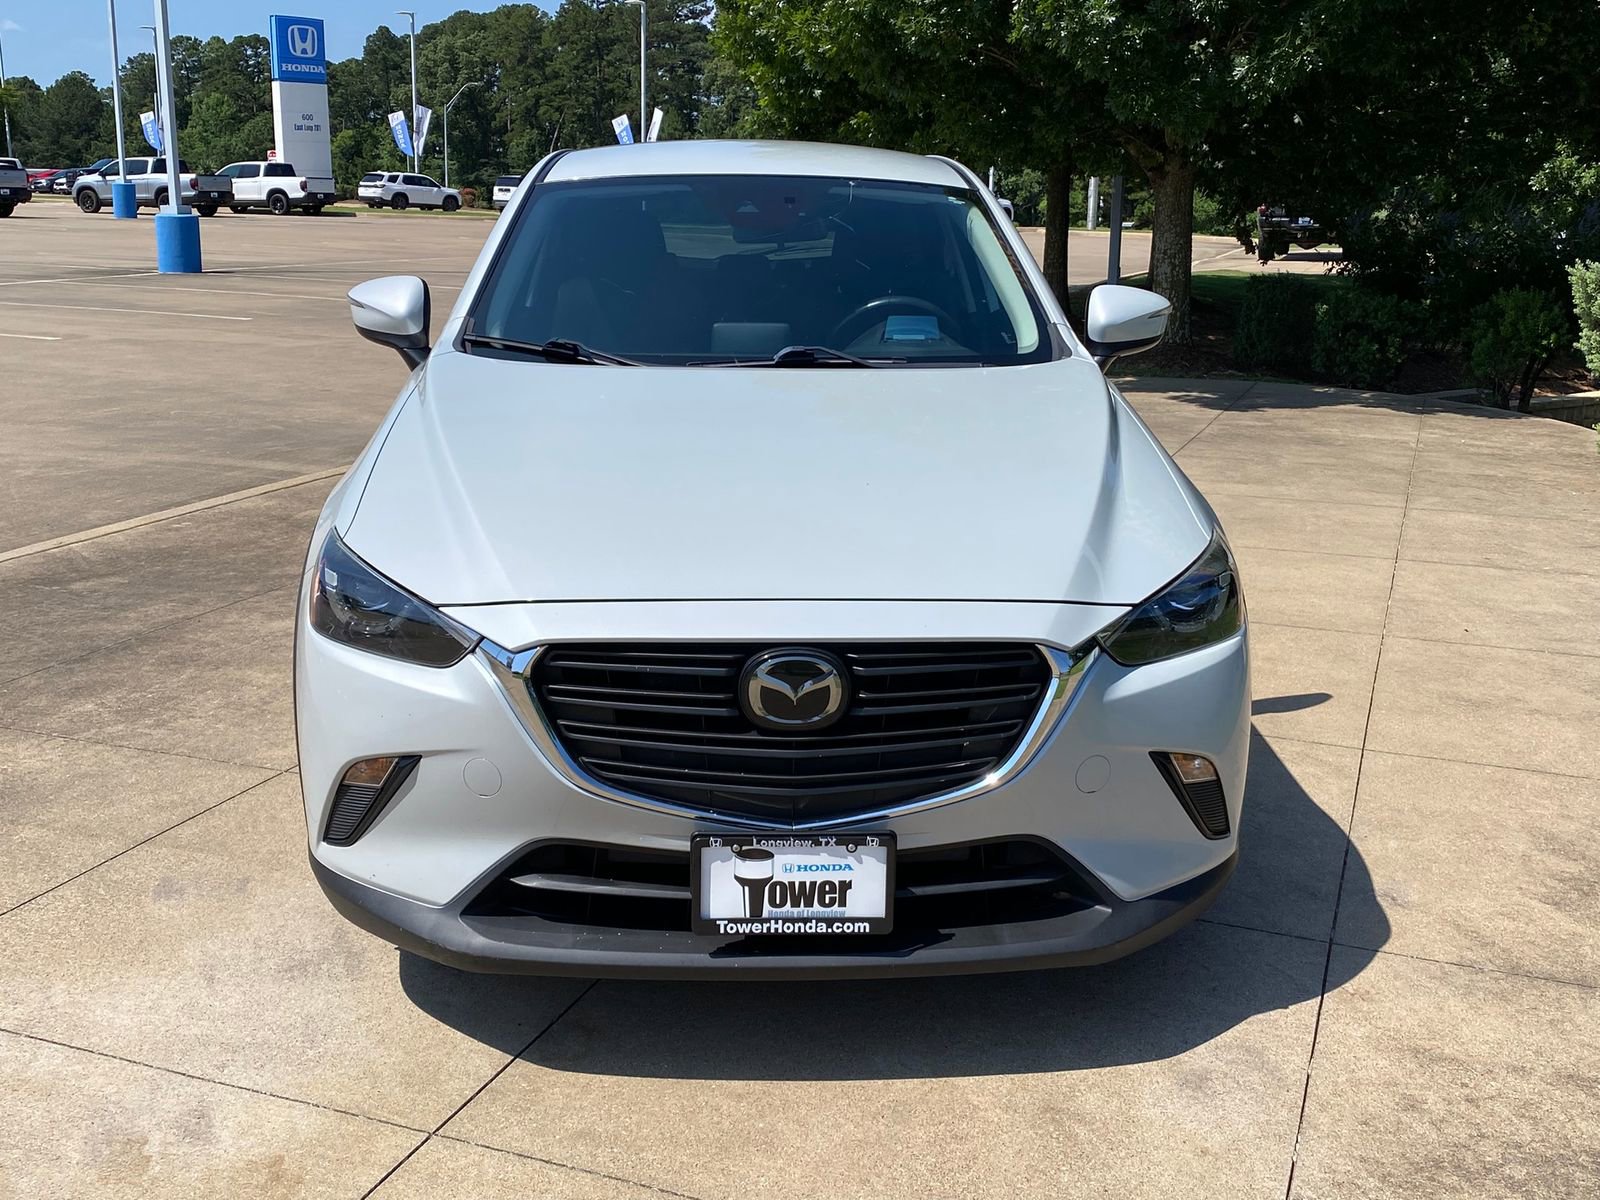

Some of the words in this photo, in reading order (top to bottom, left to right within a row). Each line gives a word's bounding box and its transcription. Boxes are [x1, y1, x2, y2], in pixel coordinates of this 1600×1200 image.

[281, 63, 325, 73] HONDA
[302, 113, 313, 121] 600
[819, 836, 837, 847] TX
[796, 863, 854, 873] HONDA
[768, 910, 792, 918] Honda
[796, 910, 805, 918] of
[716, 920, 870, 934] TowerHonda.com
